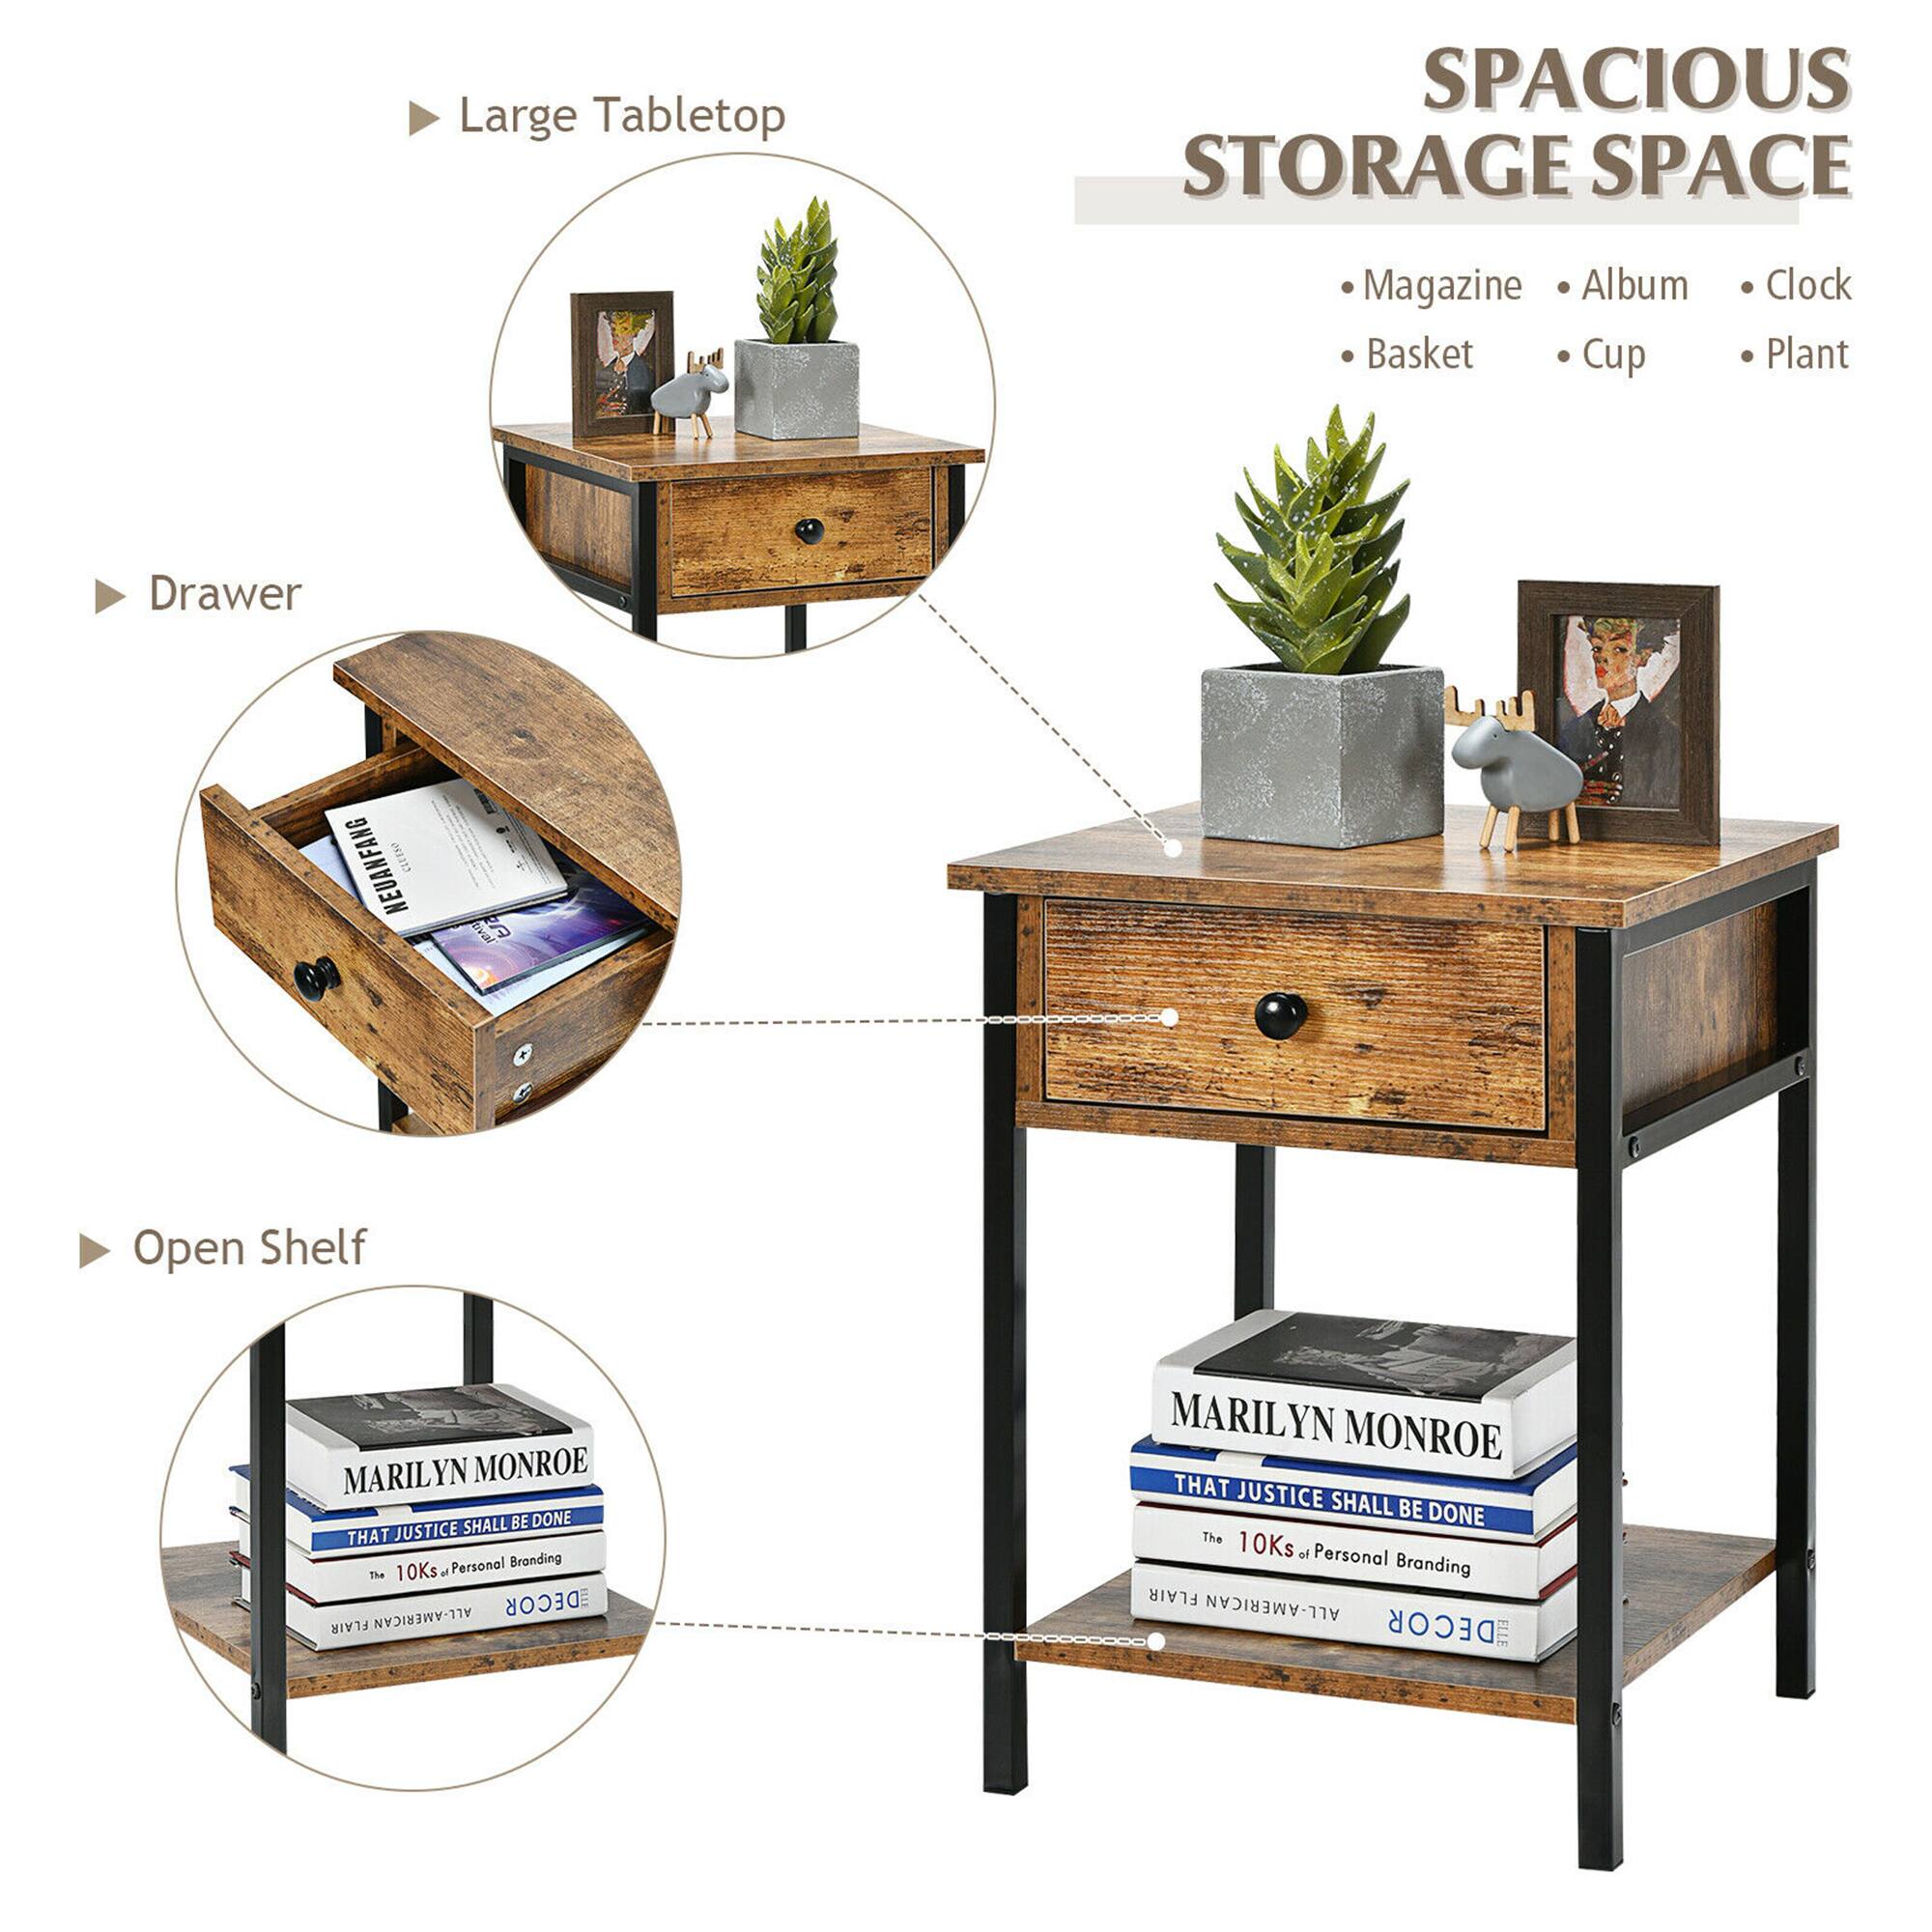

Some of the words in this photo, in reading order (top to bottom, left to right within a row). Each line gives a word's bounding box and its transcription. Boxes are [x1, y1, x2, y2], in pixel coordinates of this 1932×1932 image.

[345, 817, 409, 915] NEUANFANG
[1171, 1391, 1335, 1442] MARILYN
[1345, 1409, 1502, 1460] MONROE
[343, 1457, 468, 1495] MARILYN
[474, 1446, 588, 1483] MONROE
[1174, 1473, 1230, 1496] THAT
[1237, 1479, 1323, 1507] JUSTICE
[1332, 1492, 1393, 1517] SHALL
[1399, 1500, 1423, 1520] BE
[1429, 1502, 1485, 1526] DONE
[348, 1529, 387, 1546] THAT
[394, 1521, 458, 1542] JUSTICE
[463, 1515, 508, 1536] SHALL
[512, 1513, 529, 1530] BE
[532, 1510, 572, 1529] DONE
[370, 1571, 384, 1580] The
[396, 1561, 438, 1581] 10Ks
[440, 1569, 449, 1577] of
[452, 1553, 505, 1575] Personal
[510, 1552, 562, 1568] Branding
[1203, 1531, 1222, 1545] The
[1238, 1530, 1294, 1558] 10Ks
[1298, 1548, 1310, 1560] of
[1315, 1544, 1389, 1567] Personal
[1397, 1552, 1471, 1578] Branding
[506, 1590, 580, 1616] DECOR
[580, 1588, 588, 1608] ELLE
[1149, 1587, 1198, 1606] FLAIR
[1207, 1595, 1341, 1621] ALL-AMERICAN
[331, 1619, 369, 1634] FLAIR
[374, 1607, 471, 1631] ALL-AMERICAN
[1388, 1608, 1495, 1644] DECOR
[1497, 1619, 1509, 1647] ELLE
